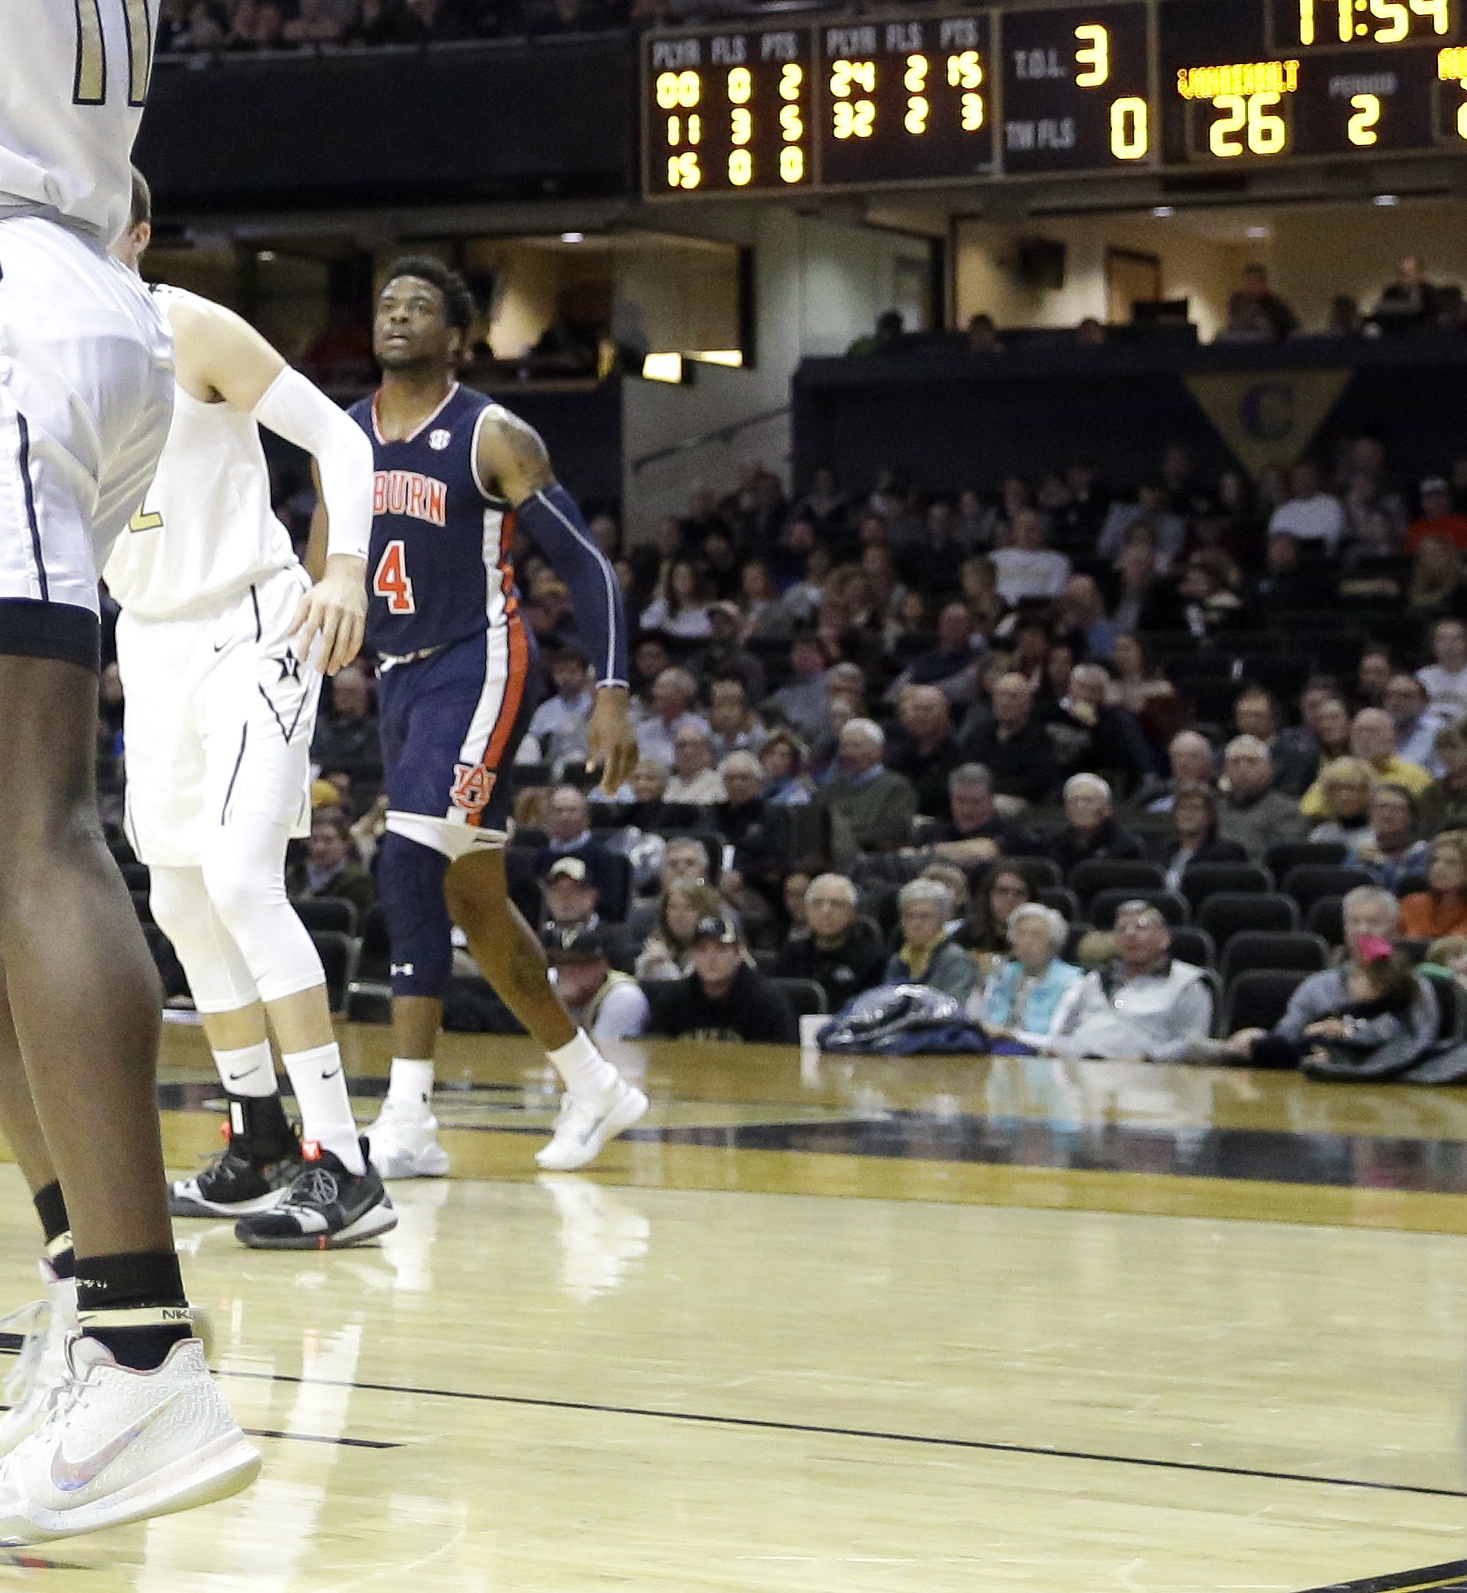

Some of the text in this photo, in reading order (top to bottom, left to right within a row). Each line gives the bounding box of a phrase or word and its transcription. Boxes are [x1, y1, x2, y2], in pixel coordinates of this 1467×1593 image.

[830, 51, 982, 97] 24 2 15
[1074, 24, 1108, 86] 3
[657, 63, 802, 109] 00 0 2
[668, 104, 803, 145] 11 3 5
[833, 93, 983, 139] 32 2 3
[1110, 97, 1147, 159] 0
[1209, 92, 1285, 157] 26
[1348, 94, 1380, 145] 2
[668, 146, 803, 189] 15 0 0
[373, 470, 448, 527] BURN
[374, 540, 416, 614] 4
